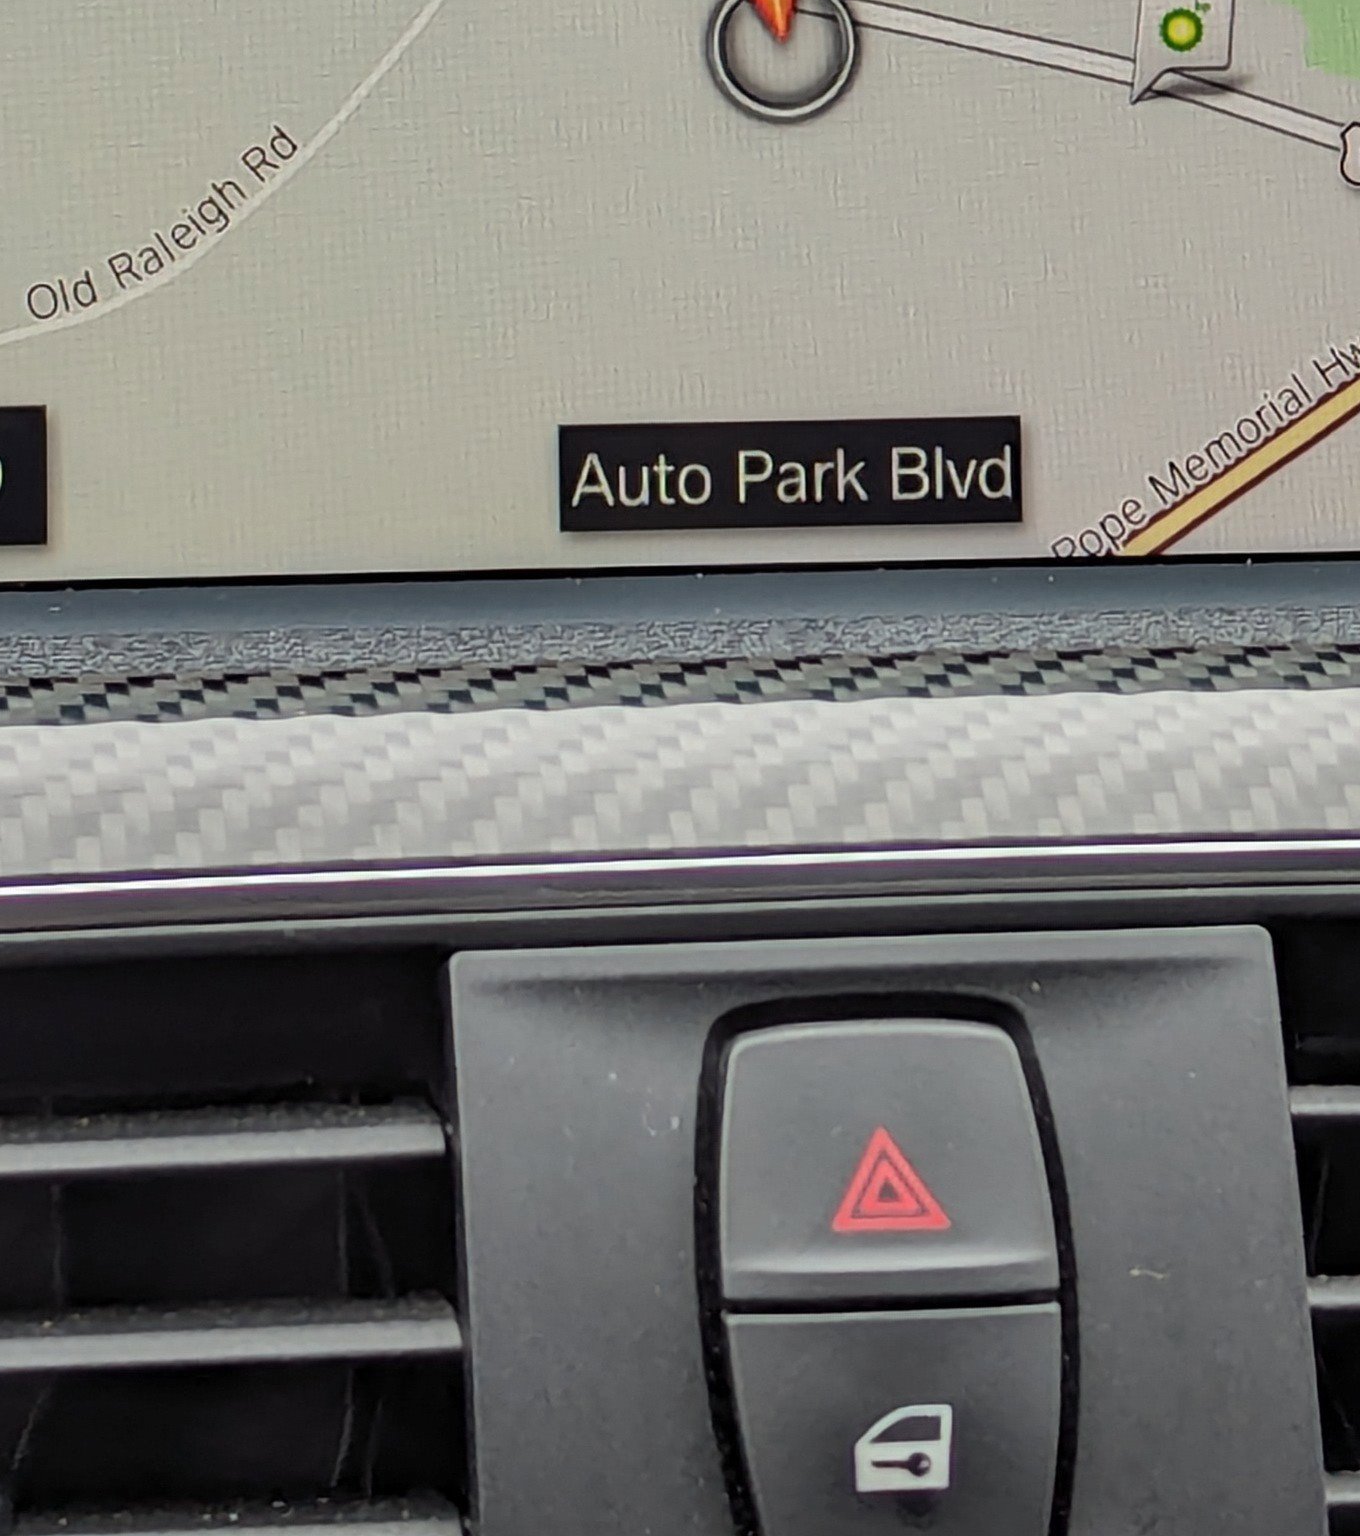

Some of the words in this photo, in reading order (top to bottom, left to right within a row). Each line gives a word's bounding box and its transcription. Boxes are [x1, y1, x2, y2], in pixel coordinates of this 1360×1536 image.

[27, 270, 97, 319] Old
[108, 179, 247, 289] Raleigh
[241, 125, 298, 182] Rd
[571, 451, 712, 507] Auto
[738, 448, 868, 504] Park
[891, 445, 1012, 500] Blvd
[1149, 373, 1312, 506] Memorial
